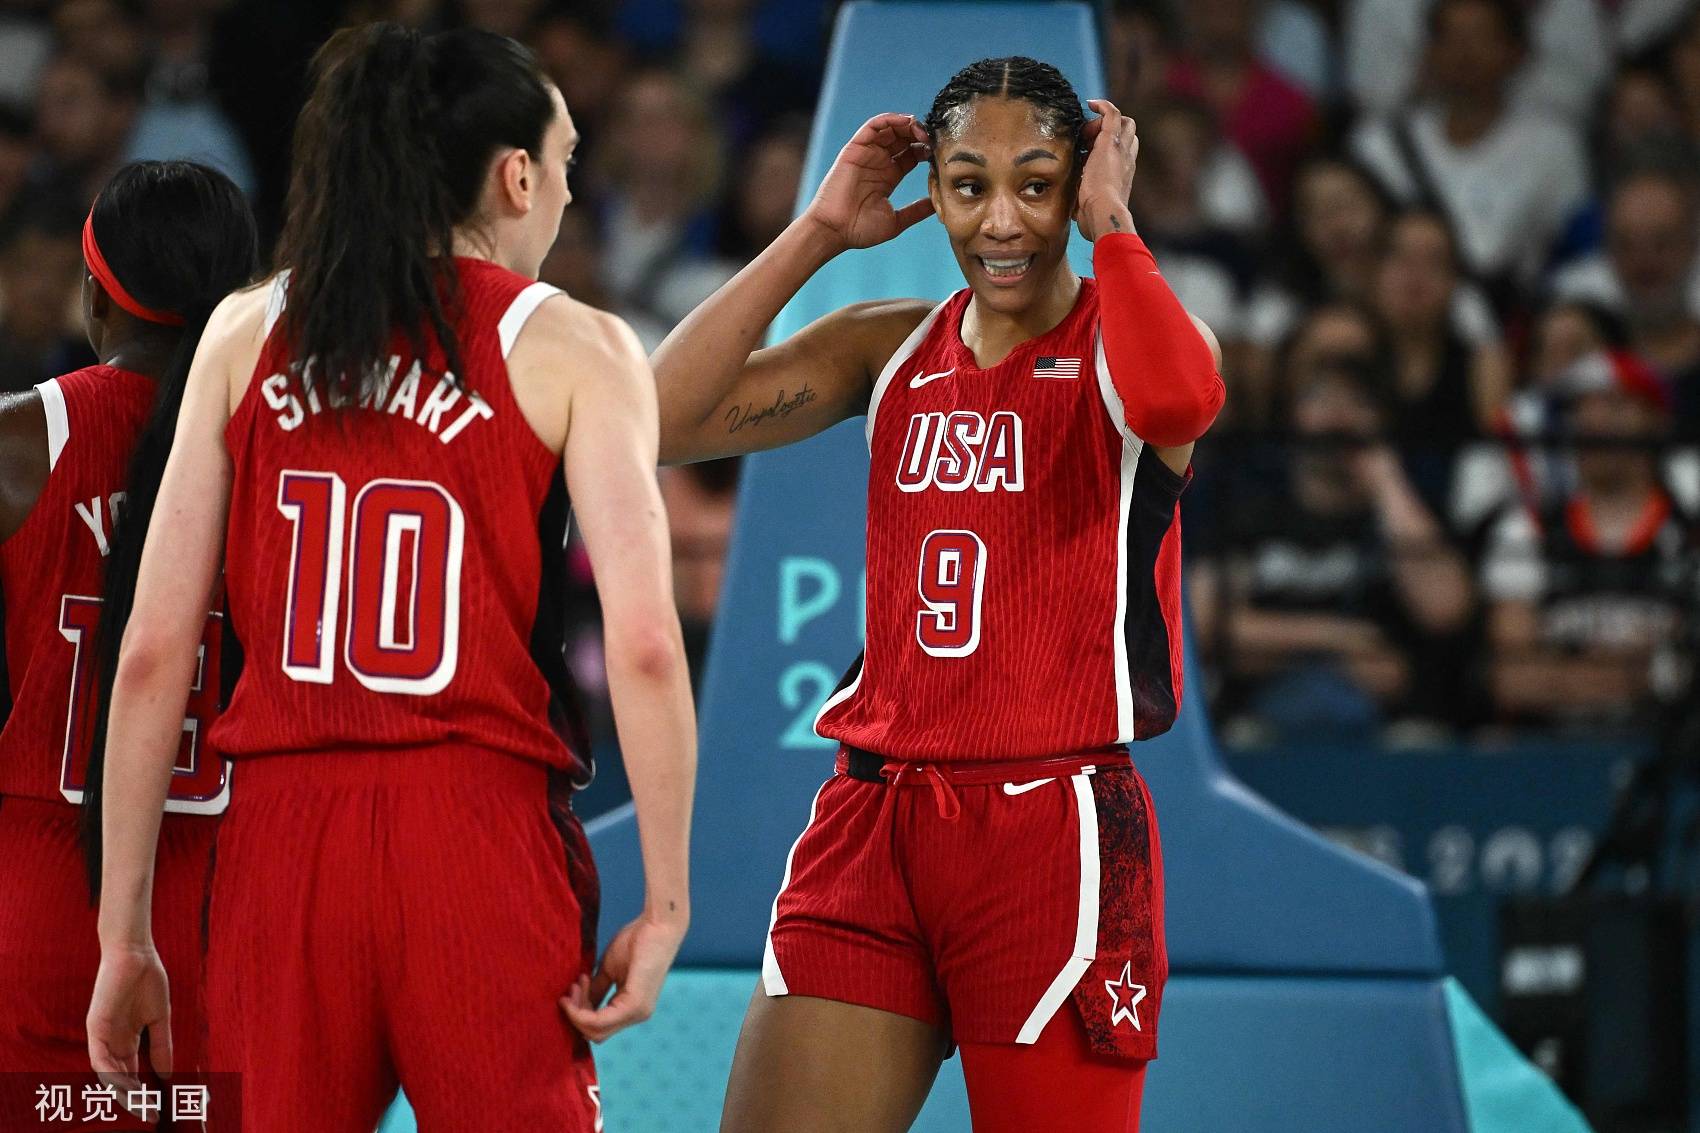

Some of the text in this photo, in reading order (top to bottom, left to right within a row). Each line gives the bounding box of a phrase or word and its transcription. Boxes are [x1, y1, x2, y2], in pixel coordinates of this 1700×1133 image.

[896, 411, 1024, 492] USA
[277, 469, 464, 695] 10
[916, 530, 987, 657] 9
